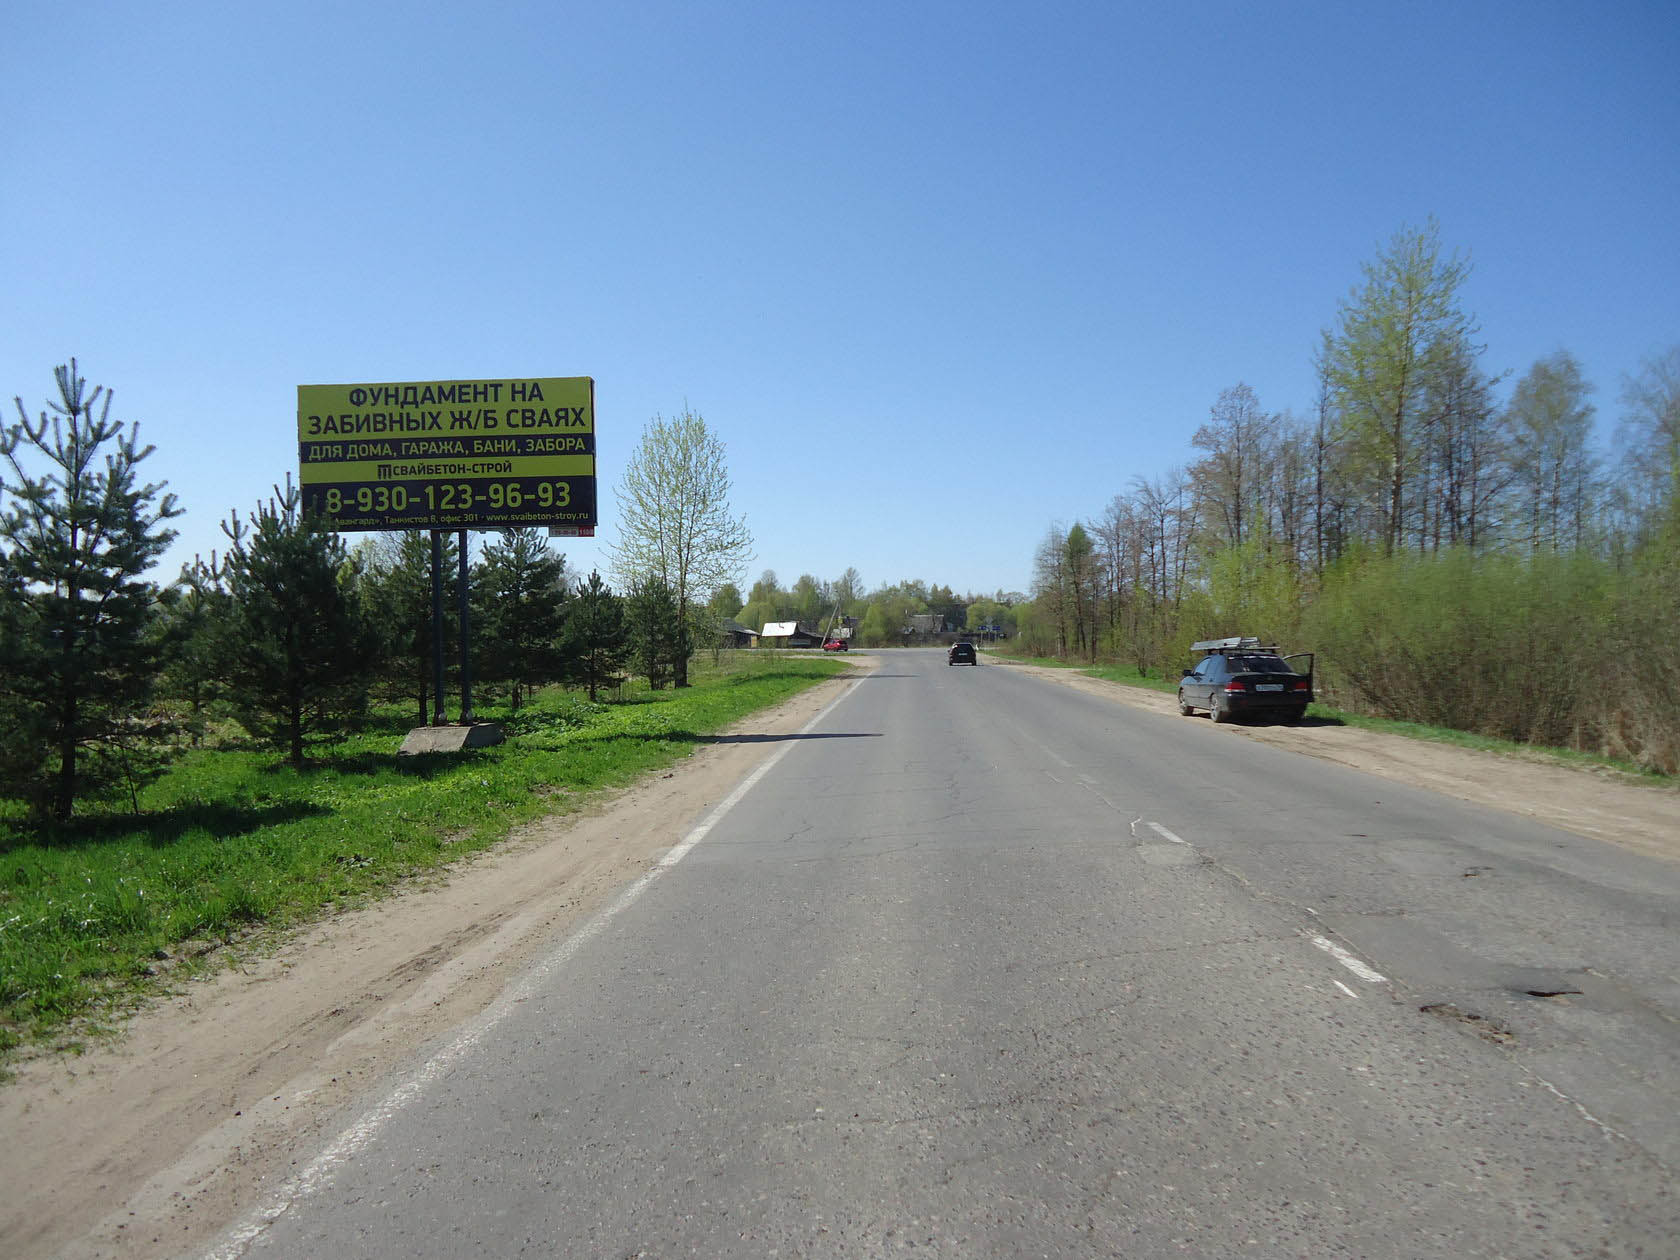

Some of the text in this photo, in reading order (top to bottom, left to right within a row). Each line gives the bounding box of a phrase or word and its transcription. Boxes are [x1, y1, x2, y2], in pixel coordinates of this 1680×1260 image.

[349, 383, 544, 408] ФУНДАМЕНТ НА
[308, 407, 586, 435] ЗАБИВНЫХ Ж/Б СВАЯХ
[309, 437, 586, 461] ДЛЯ ДОМА, ГАРАЖА, БАНИ, ЗАБОРА
[393, 460, 512, 477] СВАЙБЕТОН-СТРОЙ
[326, 481, 571, 514] 8-930-123-96-93
[384, 515, 428, 525] Танкистов
[440, 513, 461, 526] офис
[463, 513, 478, 523] 301
[486, 511, 589, 523] www.svaibeton-stroy.ru
